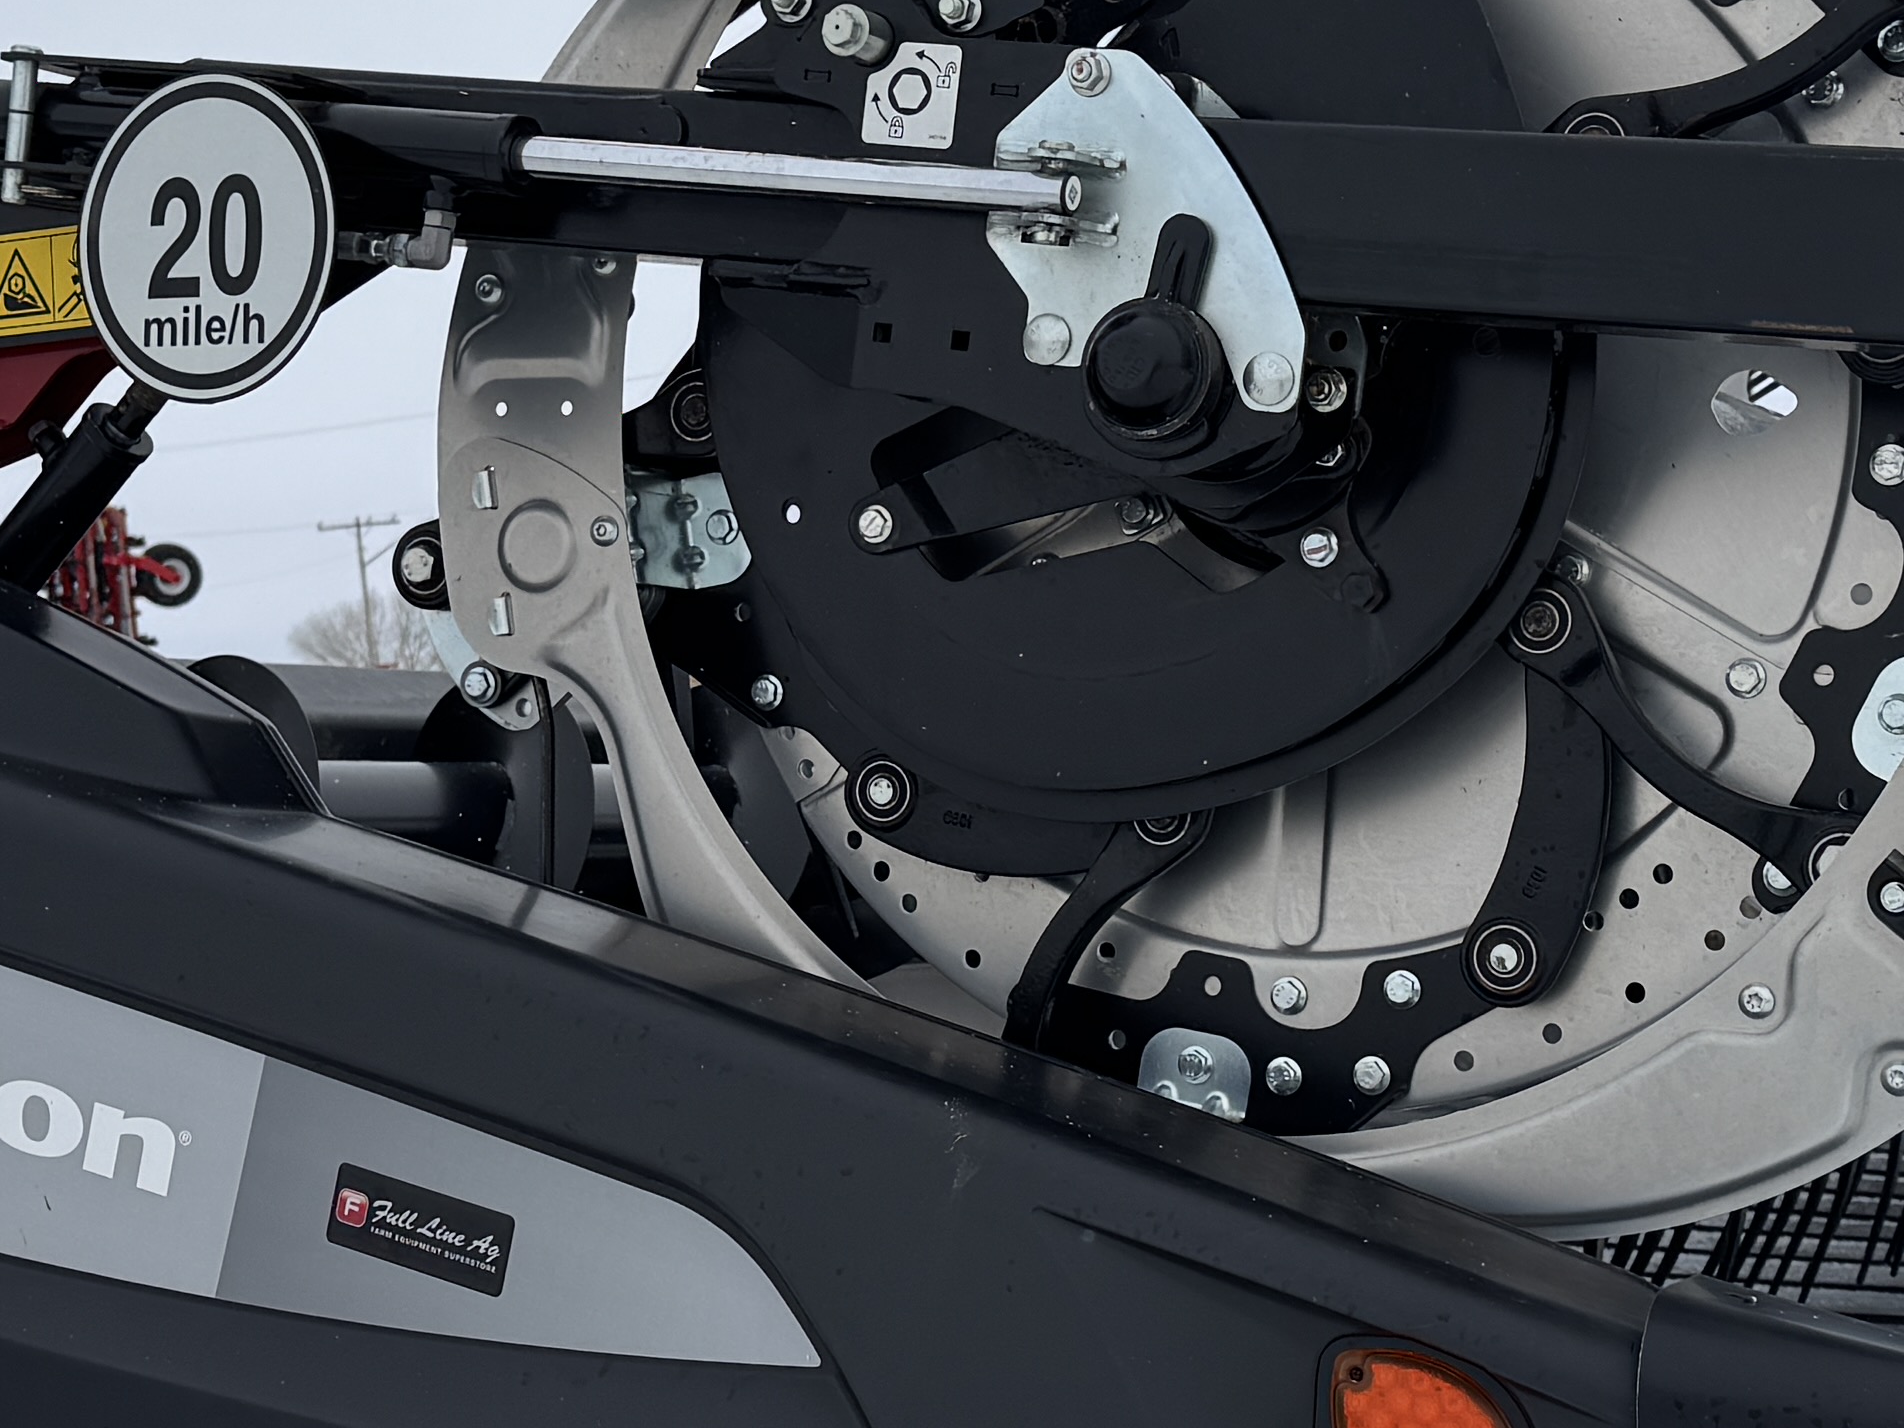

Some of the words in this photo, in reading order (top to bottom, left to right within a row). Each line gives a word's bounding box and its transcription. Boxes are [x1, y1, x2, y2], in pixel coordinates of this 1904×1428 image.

[148, 173, 263, 299] 20
[143, 302, 265, 347] mile/h
[371, 1199, 419, 1231] Full
[417, 1217, 466, 1247] Line
[467, 1234, 501, 1263] Ag
[394, 1234, 442, 1256] EQUIPMENT
[444, 1249, 497, 1274] SUPERSTORE
